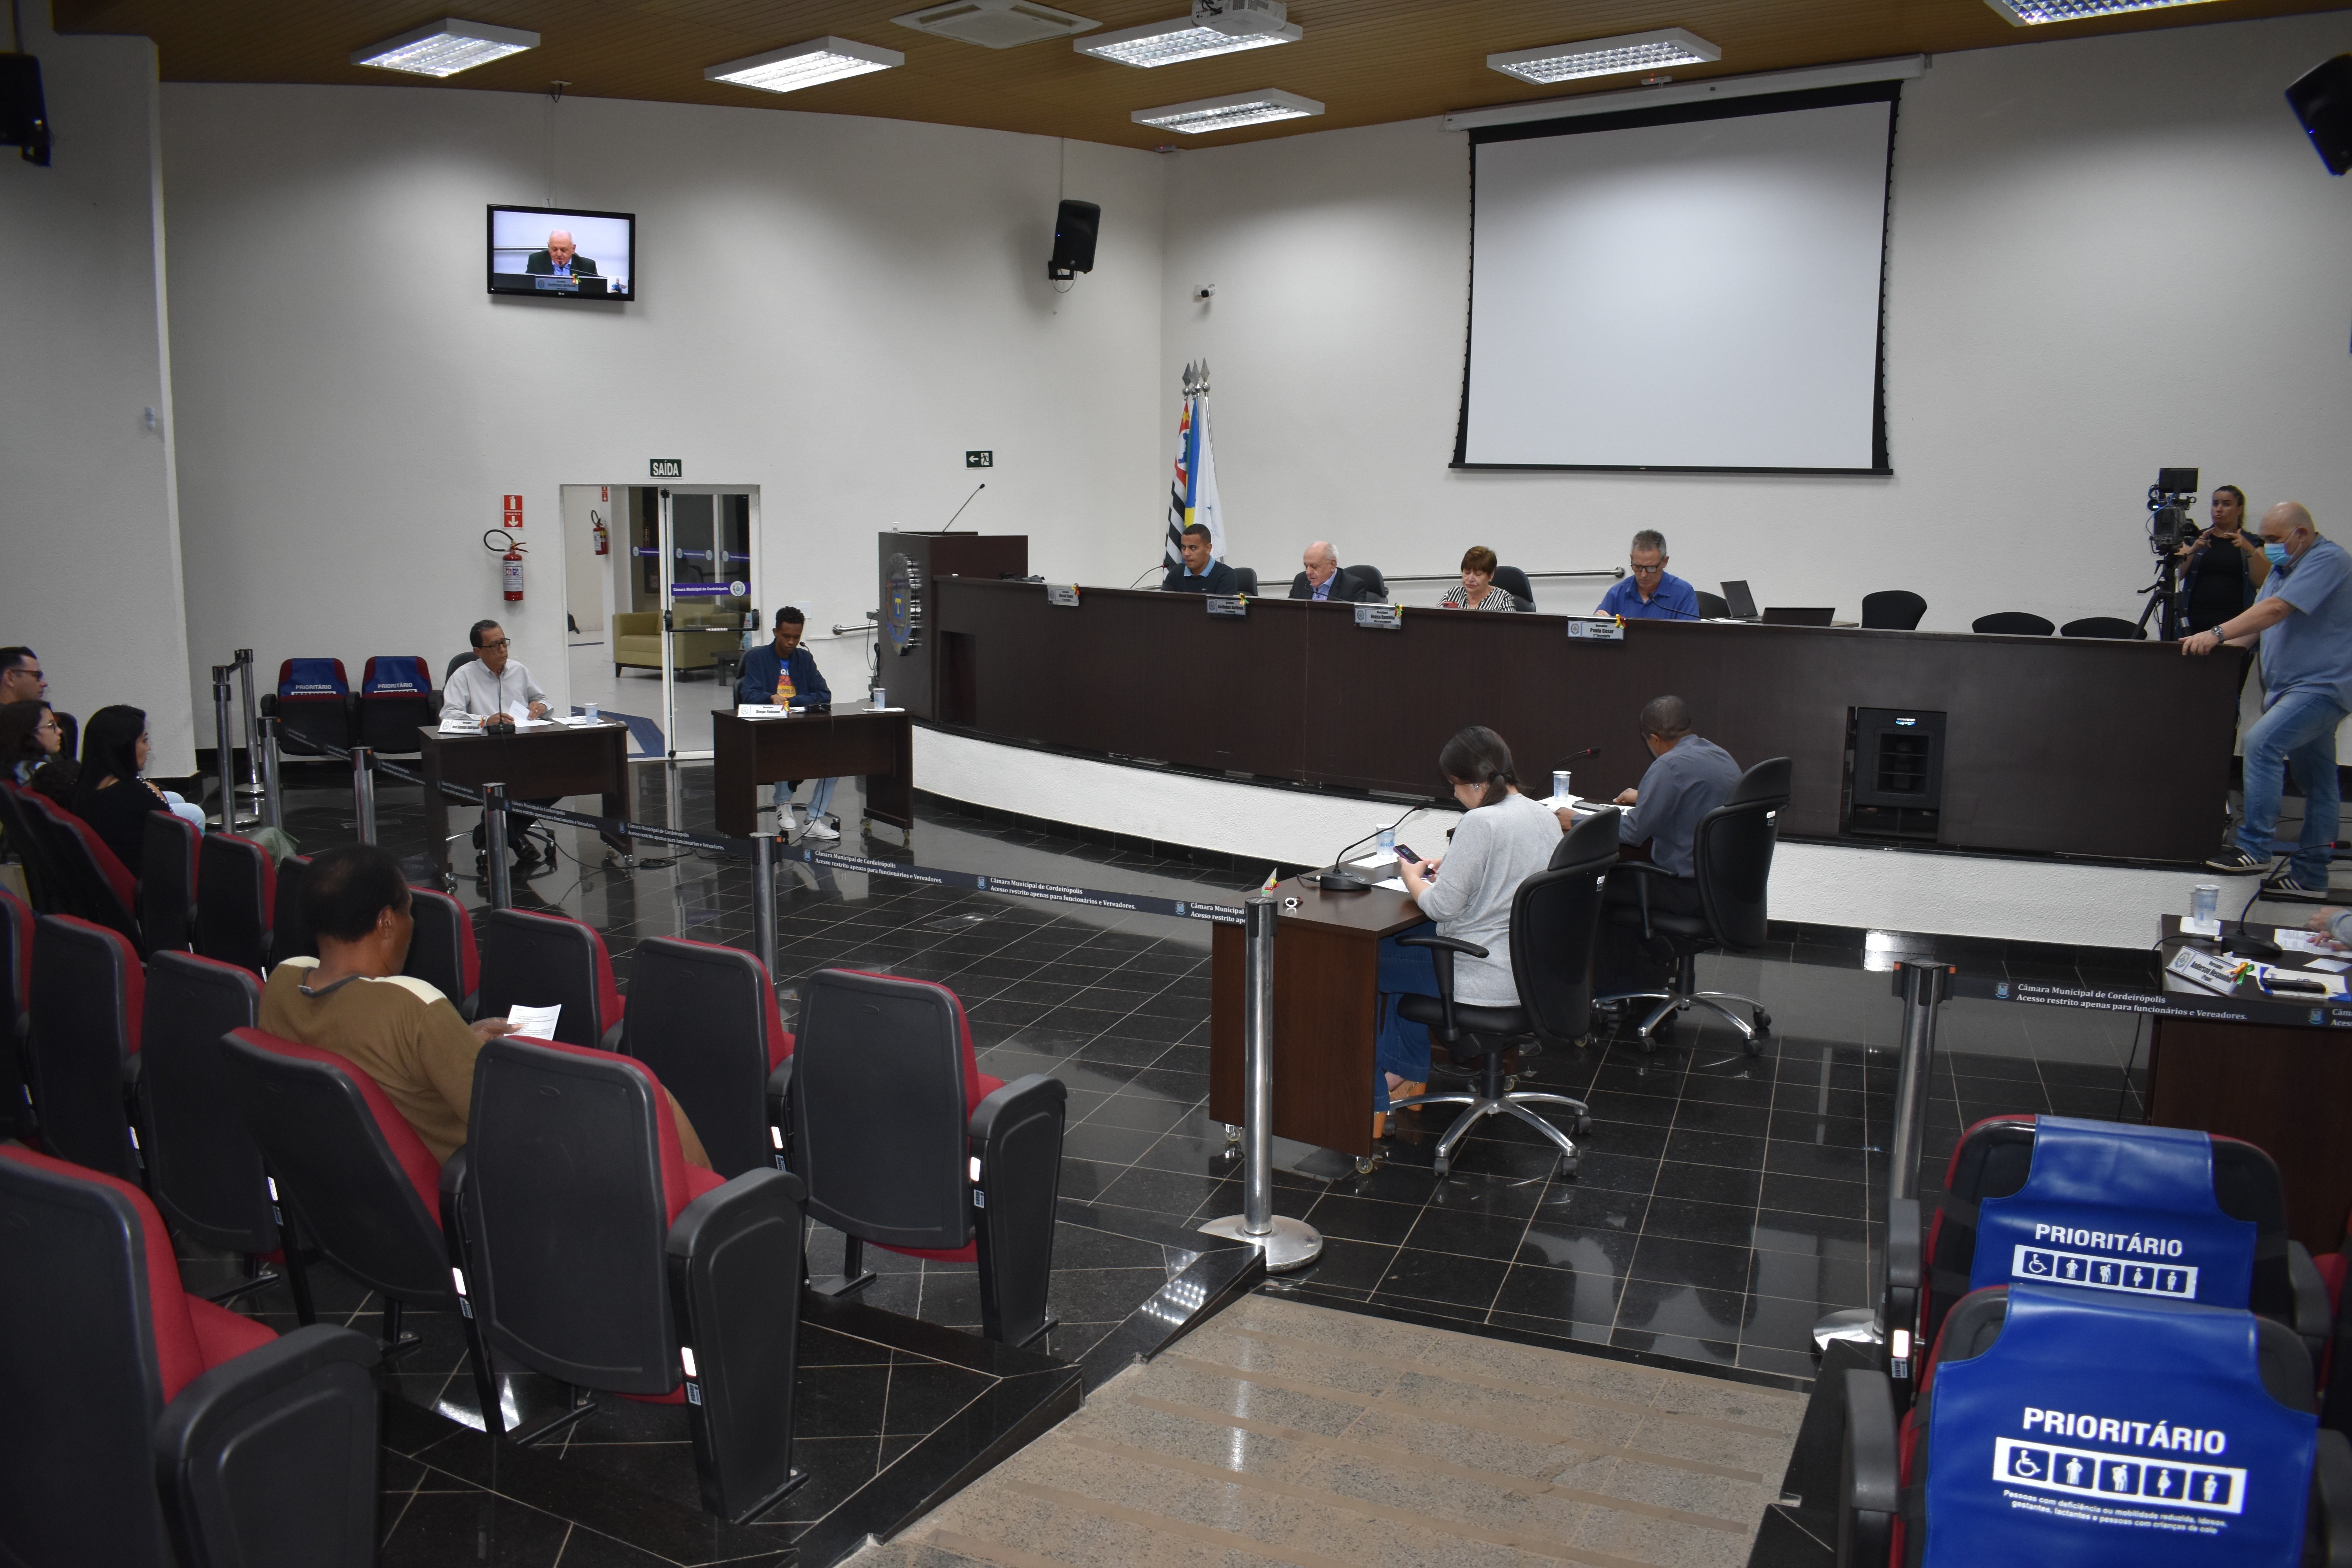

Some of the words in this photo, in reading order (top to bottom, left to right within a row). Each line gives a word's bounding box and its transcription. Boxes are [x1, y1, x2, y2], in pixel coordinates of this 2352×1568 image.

[653, 460, 679, 476] SAÍDA
[664, 829, 690, 838] Cordeirópolis
[676, 838, 699, 847] funcionários
[833, 854, 856, 863] Municipal
[864, 858, 896, 869] Cordeirópolis
[878, 868, 909, 879] funcionários
[913, 874, 943, 884] Vereadores.
[990, 877, 1010, 885] Câmara
[1011, 880, 1037, 889] Municipal
[1045, 884, 1083, 895] Cordeirópolis
[991, 885, 1008, 893] Acesso
[1009, 888, 1029, 896] restrito
[1030, 891, 1049, 900] apenas
[1063, 895, 1098, 905] funcionários
[1103, 900, 1136, 909] Vereadores.
[1190, 902, 1214, 911] Câmara
[1214, 905, 1245, 915] Municipal
[2190, 961, 2211, 975] Anderson
[2018, 984, 2050, 993] Câmara
[2051, 987, 2094, 998] Municipal
[2107, 992, 2166, 1004] Cordeirópolis
[2016, 994, 2045, 1003] Acesso
[2047, 998, 2079, 1006] restrito
[2134, 1004, 2187, 1015] funcionários
[2196, 1009, 2247, 1020] Vereadores.
[2035, 1223, 2182, 1256] PRIORITÁRIO
[2022, 1406, 2227, 1454] PRIORITÁRIO
[2003, 1489, 2037, 1502] Pessoas
[2039, 1497, 2056, 1505] com
[2058, 1500, 2101, 1512] deficiência
[2115, 1510, 2158, 1519] mobilidade
[2160, 1514, 2196, 1523] reduzida,
[2011, 1500, 2053, 1514] gestantes,
[2054, 1507, 2091, 1520] lactantes
[2099, 1515, 2132, 1525] pessoas
[2153, 1521, 2186, 1530] crianças
